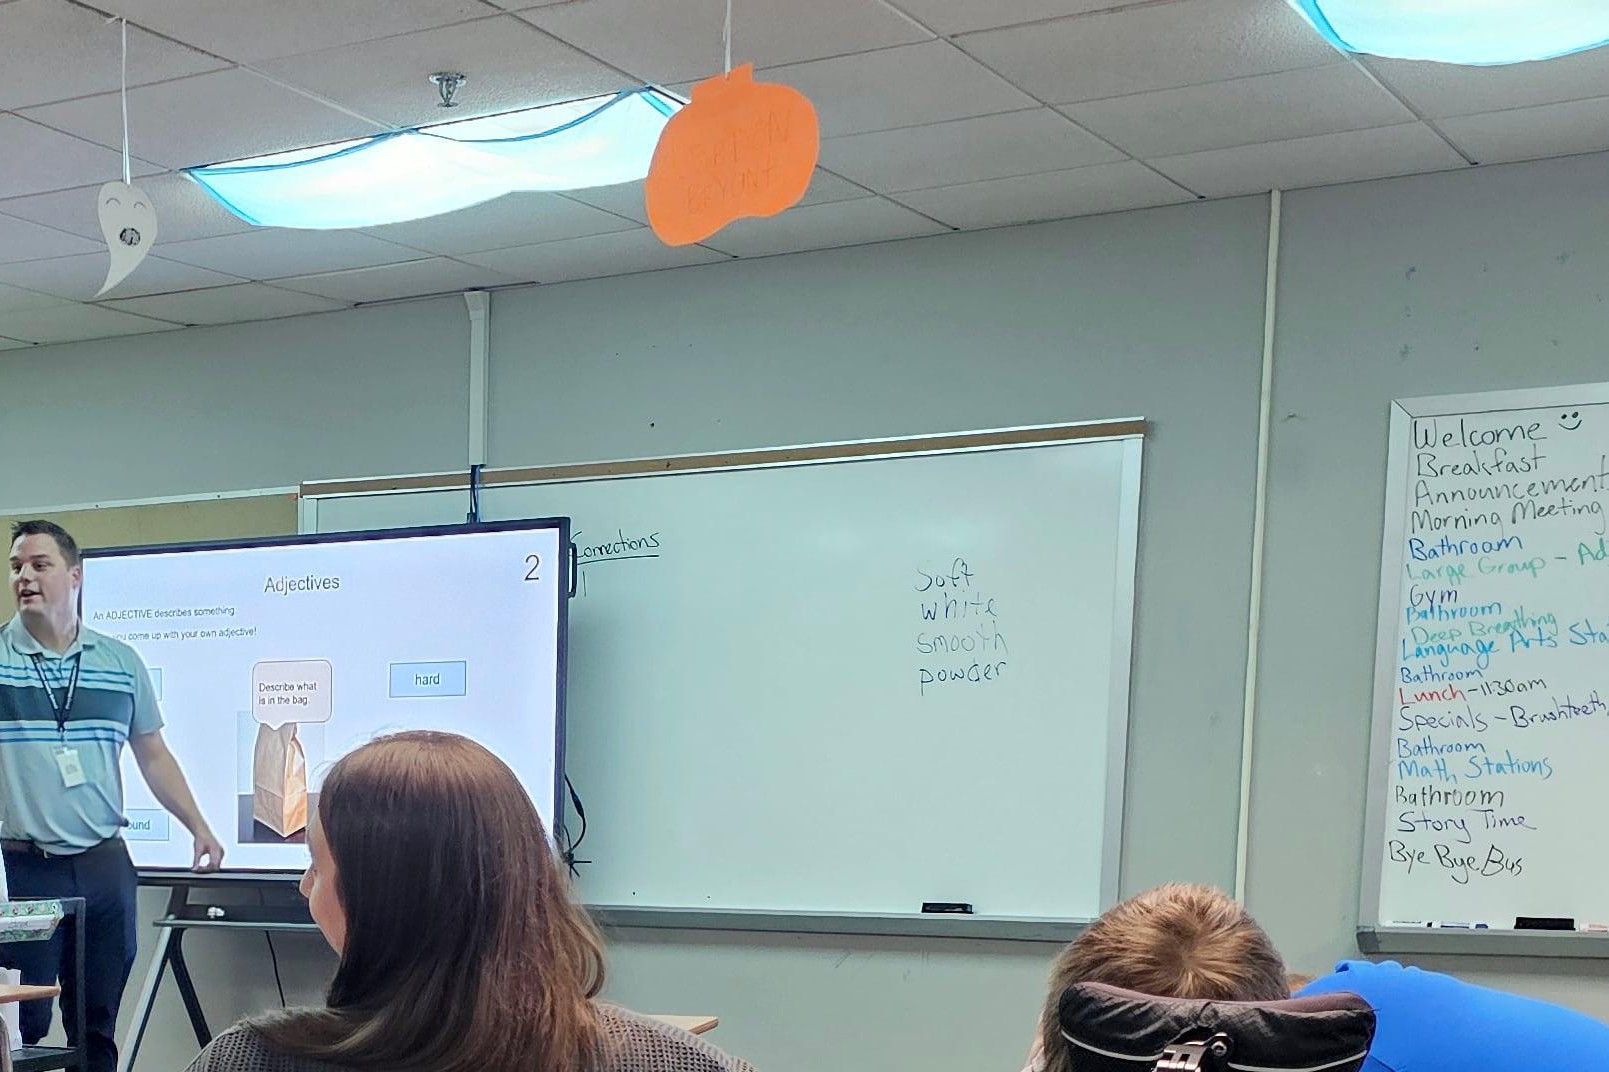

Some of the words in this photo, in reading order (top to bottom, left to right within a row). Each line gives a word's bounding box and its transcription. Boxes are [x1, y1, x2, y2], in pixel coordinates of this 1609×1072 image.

[1414, 418, 1547, 449] Welcome
[1417, 443, 1547, 477] Breakfast
[1416, 455, 1609, 507] Announcement
[1411, 509, 1504, 539] Morning
[1512, 497, 1606, 535] Meeting
[1409, 535, 1523, 561] Bathroom
[524, 554, 540, 582] 2
[1406, 563, 1470, 586] Large
[1478, 557, 1546, 578] Group
[264, 574, 340, 597] Adjectives
[1409, 584, 1458, 612] Gym
[93, 611, 104, 621] An
[105, 609, 153, 620] ADJECTIVE
[154, 608, 191, 618] describes
[1411, 626, 1462, 645] Deep
[1468, 606, 1558, 636] Breathing
[128, 631, 149, 641] come
[151, 631, 161, 642] up
[163, 629, 179, 640] with
[181, 629, 198, 641] your
[199, 629, 217, 638] own
[218, 626, 257, 639] adjective!
[1402, 638, 1500, 670] Language
[1509, 626, 1557, 653] Arts
[258, 681, 295, 693] Describe
[296, 681, 317, 691] what
[415, 672, 440, 686] hard
[1400, 665, 1483, 684] Bathroom
[258, 695, 266, 705] is
[267, 695, 275, 705] in
[277, 695, 290, 705] the
[292, 694, 310, 706] bag.
[1398, 704, 1488, 732] Specials
[1397, 735, 1486, 759] Bathroom
[1398, 757, 1458, 784] Math
[1464, 749, 1553, 780] Stations
[1395, 784, 1504, 808] Bathroom
[128, 819, 151, 831] ound
[1397, 811, 1472, 844] Story
[1468, 808, 1537, 831] Time
[1388, 840, 1431, 874] Bye
[1433, 844, 1481, 885] Bye
[1480, 844, 1523, 877] Bus
